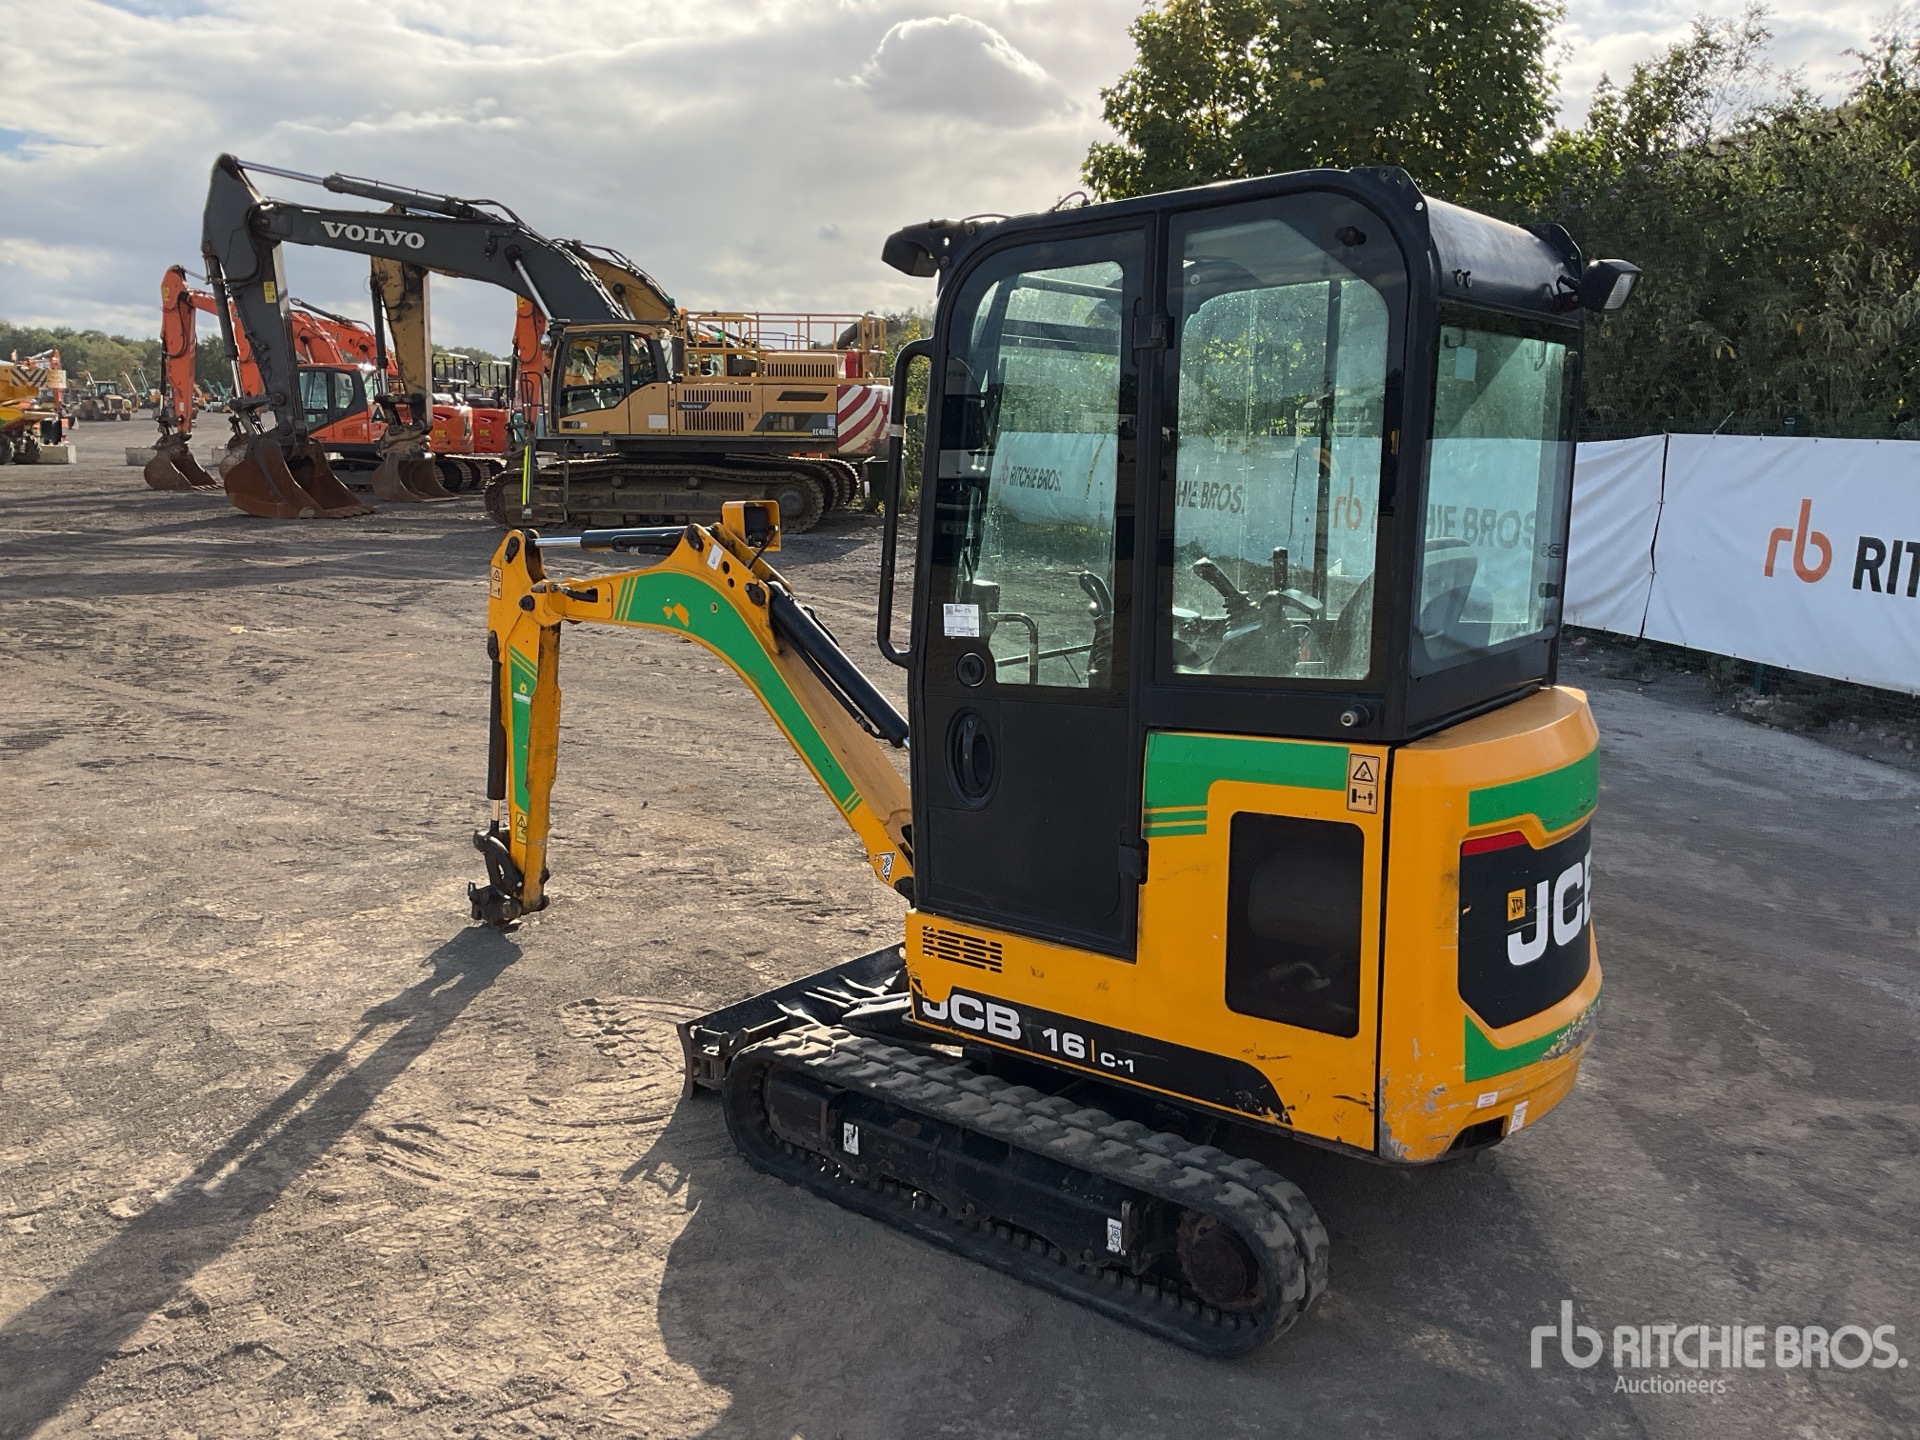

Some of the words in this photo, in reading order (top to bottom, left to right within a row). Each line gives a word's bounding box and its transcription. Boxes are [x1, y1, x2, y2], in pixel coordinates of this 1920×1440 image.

[320, 220, 426, 250] VOLVO
[1009, 465, 1039, 488] RITCHIE
[1036, 468, 1062, 492] BROS.
[1200, 481, 1245, 514] BROS.
[1332, 476, 1363, 531] rb
[1764, 498, 1833, 583] rb
[1852, 536, 1920, 598] RIT
[1507, 849, 1591, 966] JC
[1042, 1027, 1086, 1059] 16
